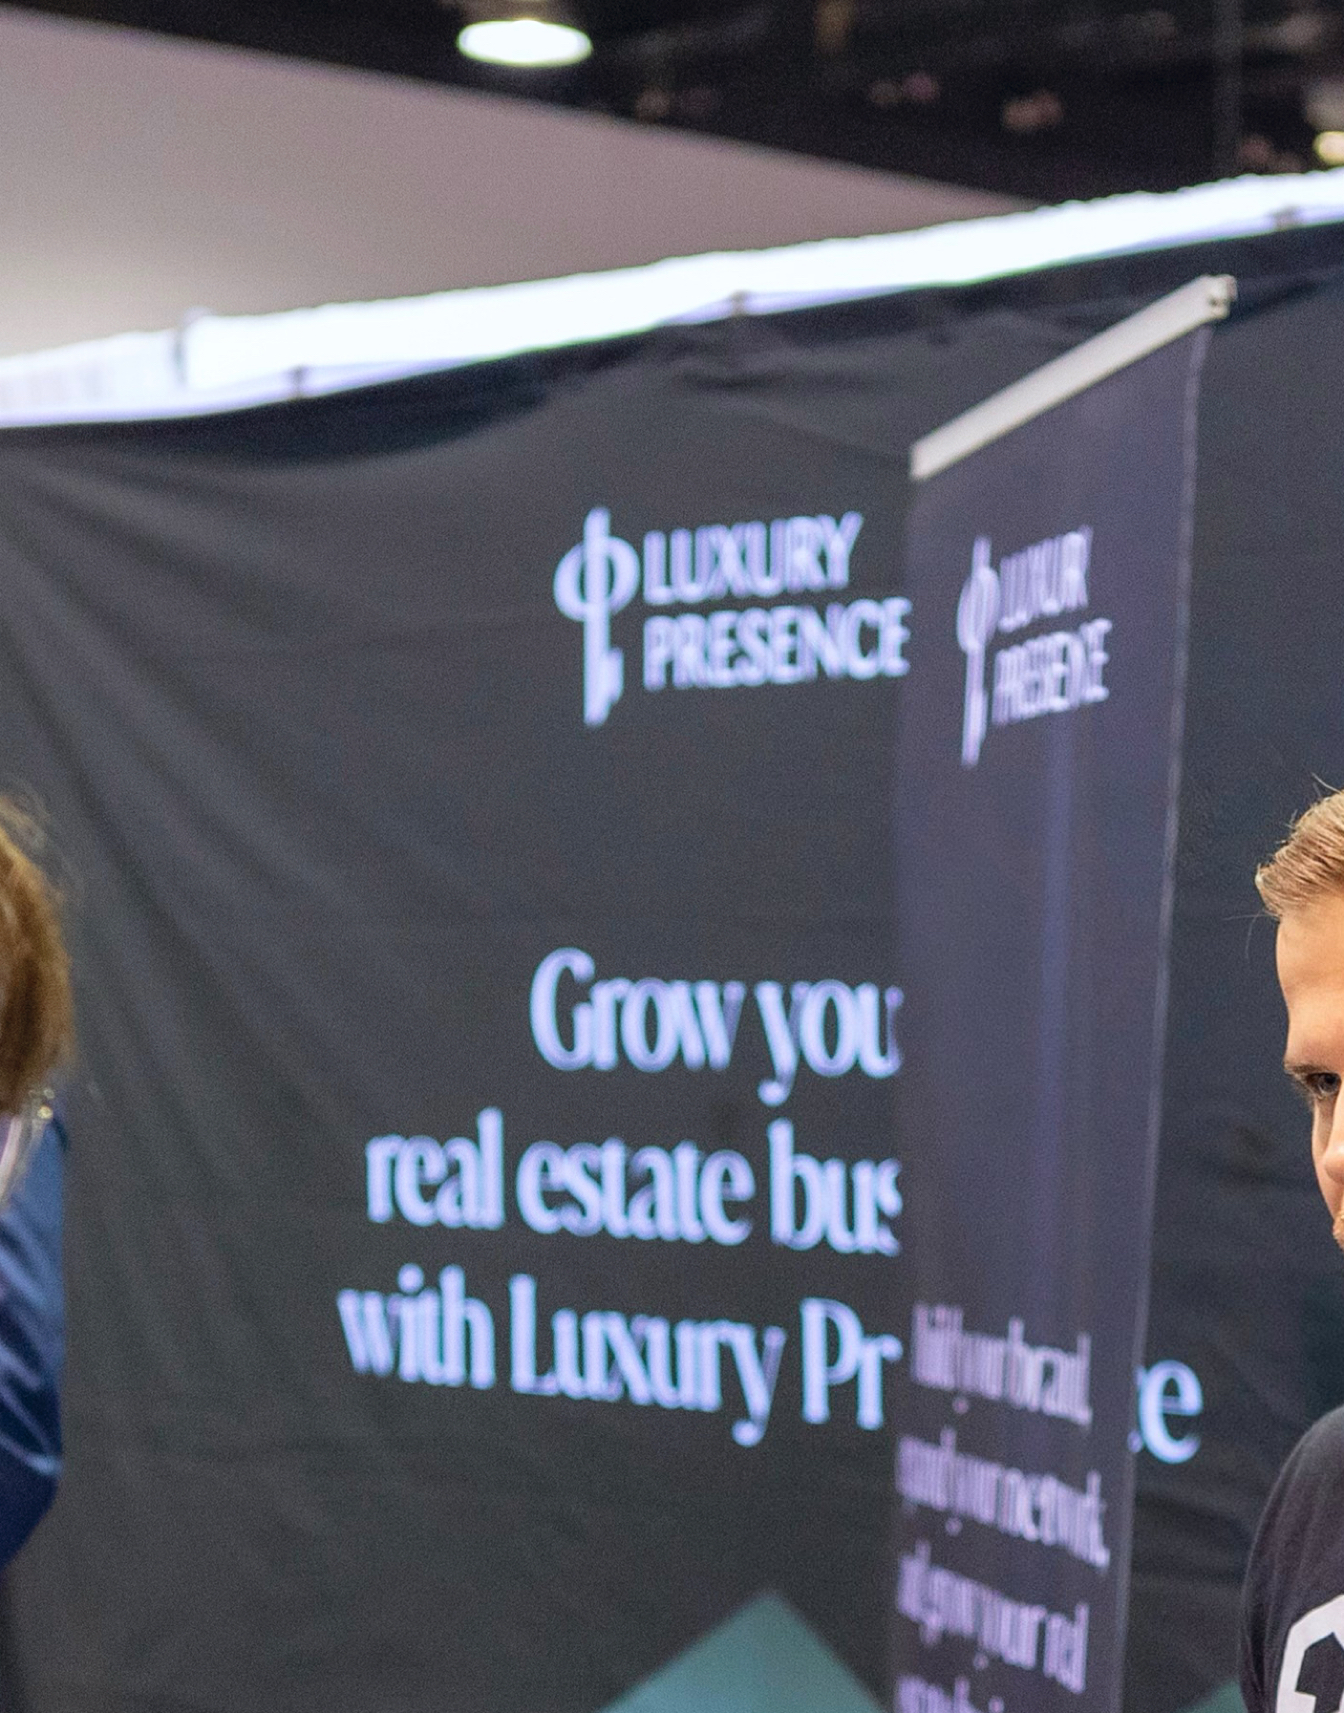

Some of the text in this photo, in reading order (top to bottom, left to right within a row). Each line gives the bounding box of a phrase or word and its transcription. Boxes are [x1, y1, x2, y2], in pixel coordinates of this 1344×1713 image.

[642, 511, 862, 605] LUXURY
[642, 595, 911, 691] PRESENCE
[531, 945, 904, 1107] Grow you
[365, 1106, 504, 1228] real
[515, 1134, 754, 1247] estate
[337, 1262, 497, 1391] with
[509, 1273, 784, 1447] Luxury
